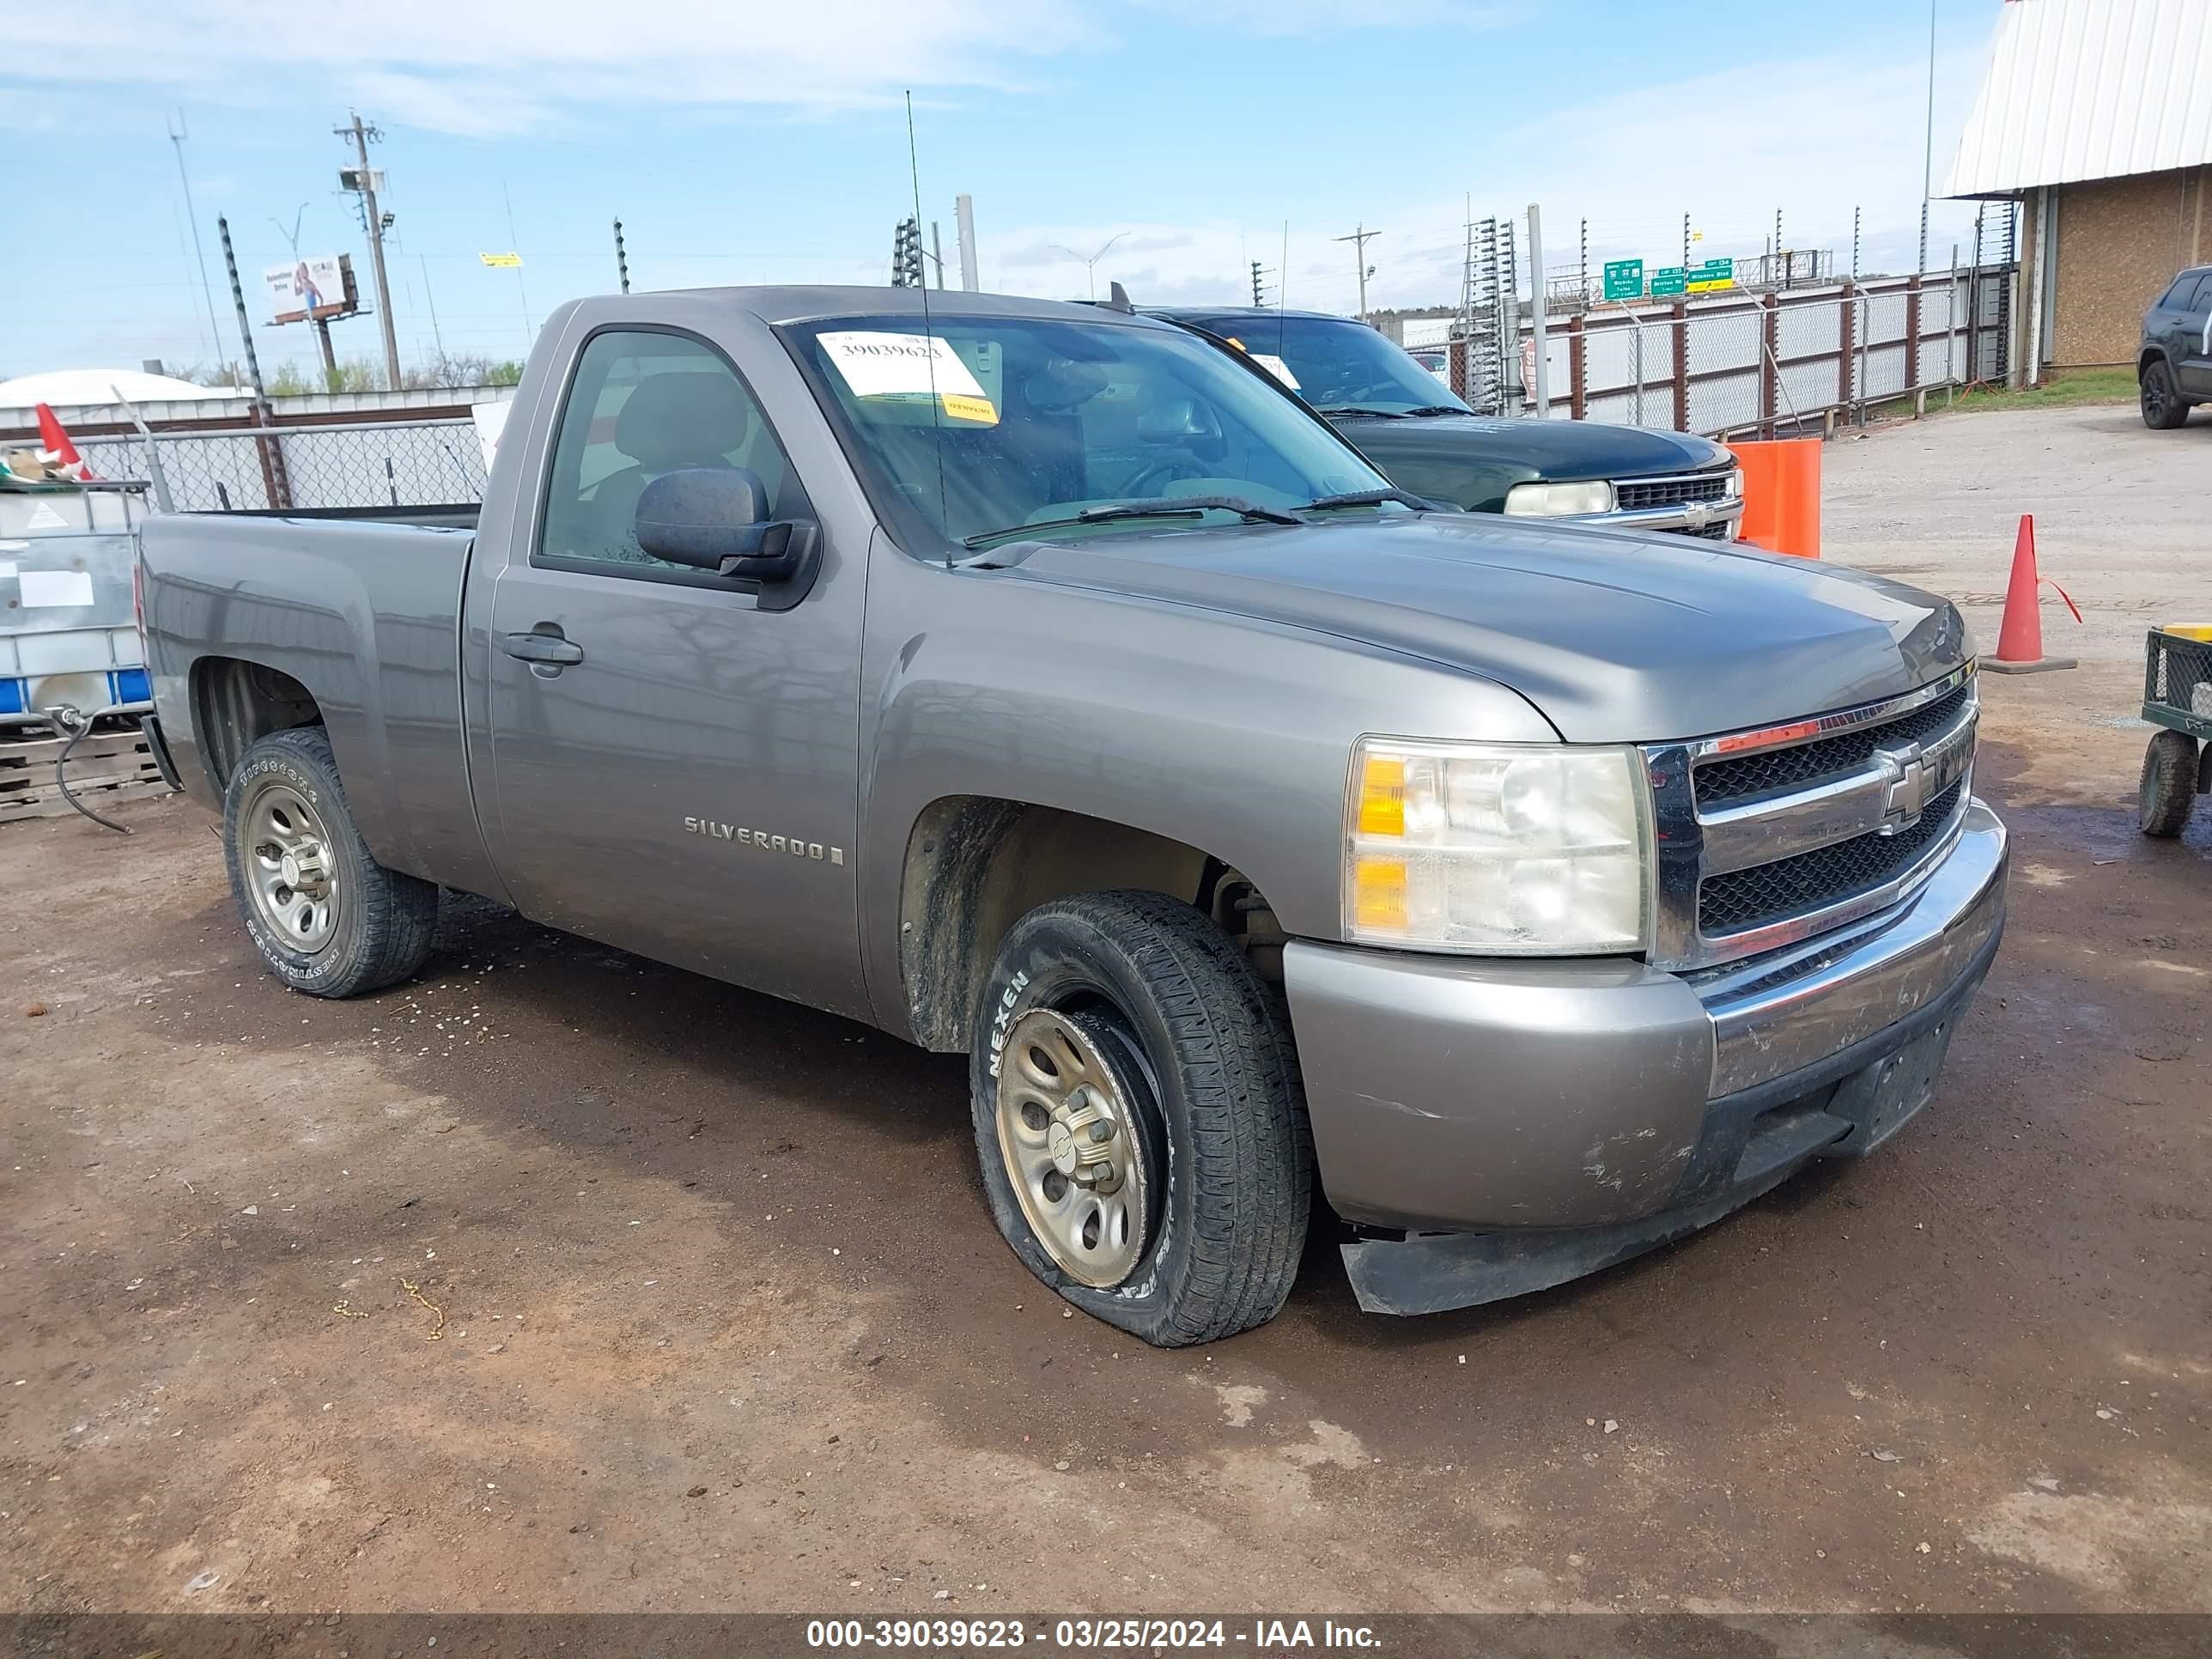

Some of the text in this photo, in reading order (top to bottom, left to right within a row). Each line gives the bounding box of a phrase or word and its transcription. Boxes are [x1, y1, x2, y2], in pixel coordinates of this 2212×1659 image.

[842, 344, 943, 359] 39039623
[1526, 351, 1535, 365] ST
[684, 816, 824, 861] SILVERADO
[246, 918, 341, 981] DESTINATION
[988, 969, 1031, 1079] NEXEN
